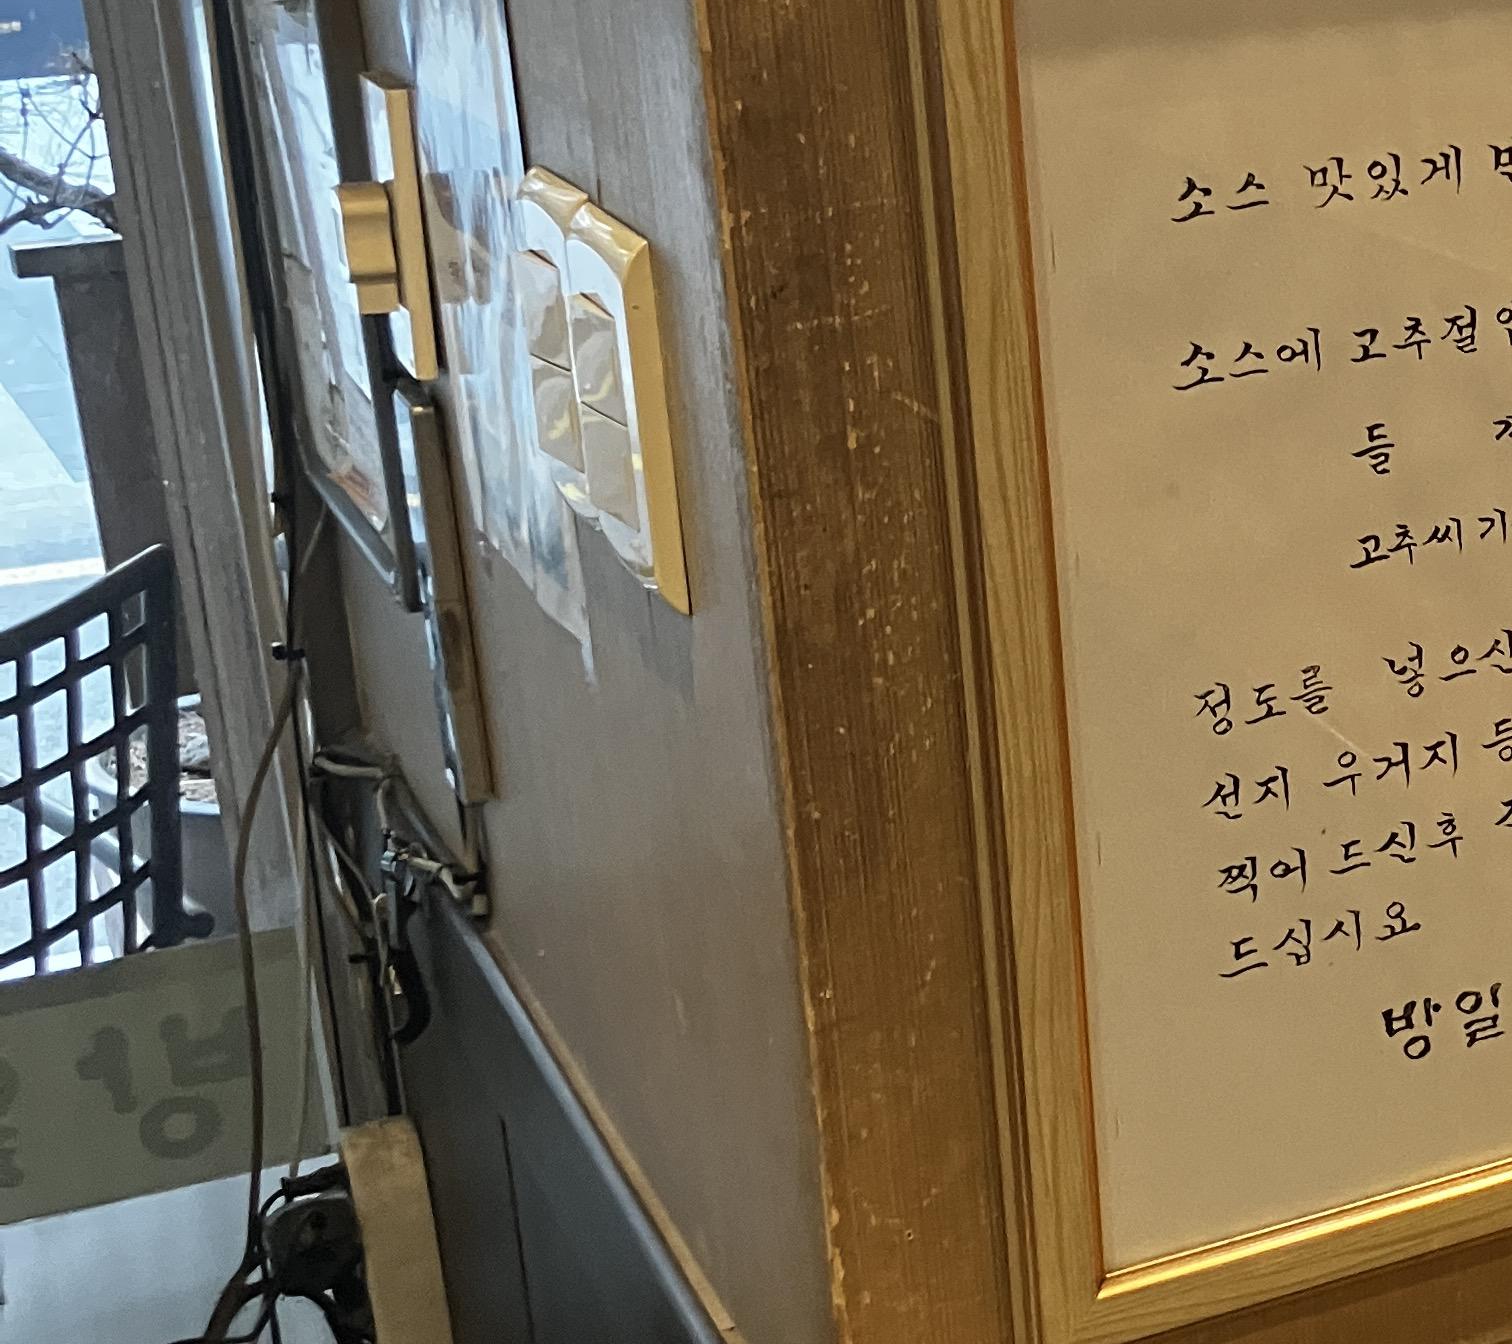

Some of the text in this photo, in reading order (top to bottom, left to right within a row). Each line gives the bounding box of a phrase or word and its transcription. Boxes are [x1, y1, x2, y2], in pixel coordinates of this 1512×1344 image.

[1171, 173, 1269, 222] 소스
[1304, 146, 1461, 208] 맛있게
[1173, 328, 1320, 390] 소스에
[1194, 665, 1332, 735] 정도를
[1202, 766, 1289, 819] 선지
[1323, 732, 1457, 796] 우거지
[1218, 848, 1306, 902] 찍어
[1219, 902, 1421, 977] 드십시요
